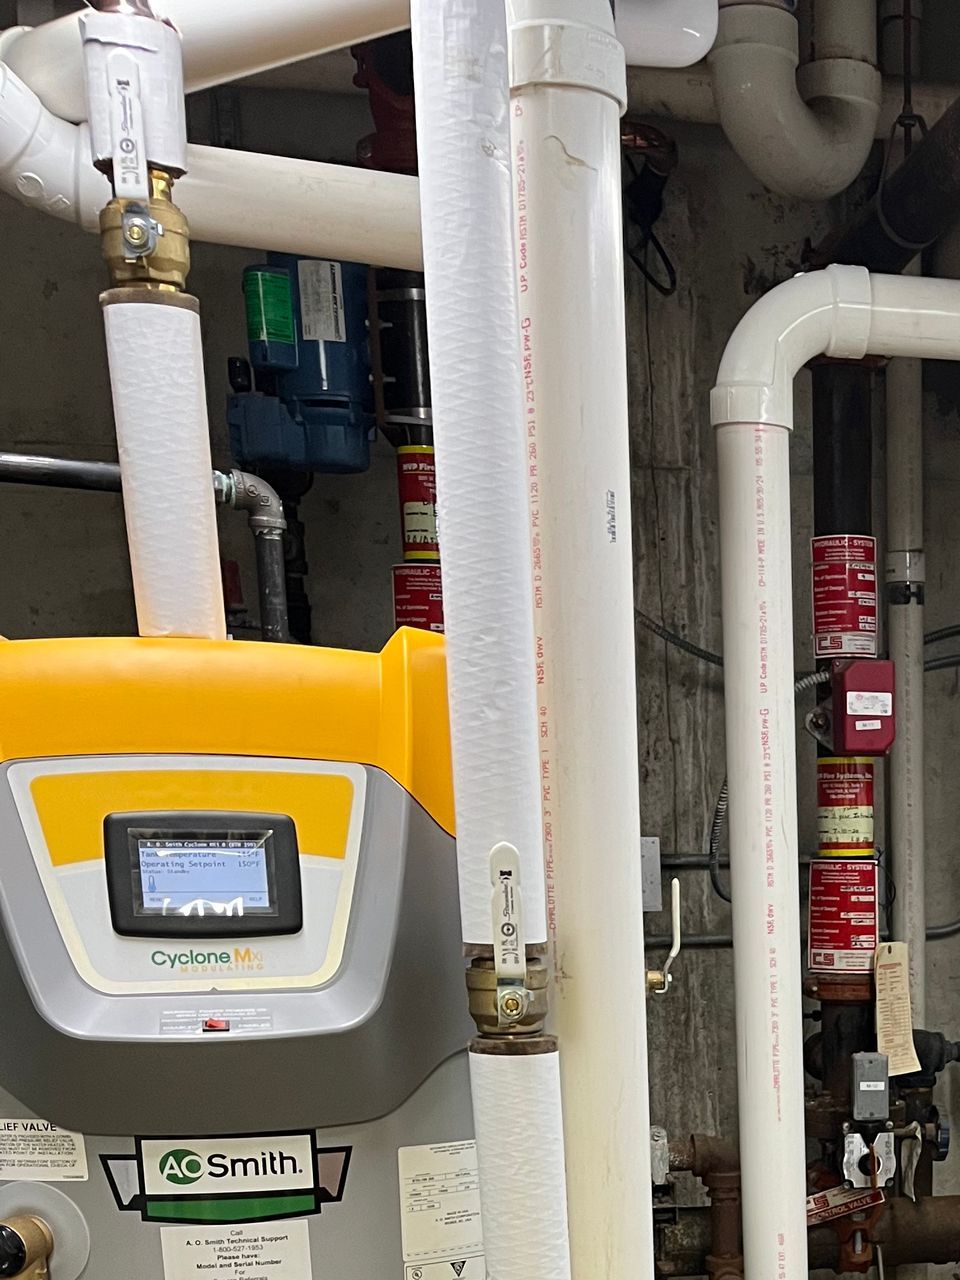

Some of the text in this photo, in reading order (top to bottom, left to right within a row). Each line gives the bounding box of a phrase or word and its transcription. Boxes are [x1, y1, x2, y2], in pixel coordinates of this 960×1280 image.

[528, 442, 536, 461] 260
[529, 482, 538, 504] 1120
[531, 509, 540, 528] PVC
[534, 586, 543, 609] ASTM
[540, 706, 547, 717] 40
[540, 721, 548, 738] SCH
[542, 759, 550, 779] TYPE
[543, 785, 551, 801] PVC
[141, 860, 185, 870] Operating
[188, 860, 227, 869] Setpoint
[151, 949, 231, 969] Cyclone
[180, 963, 265, 973] MODULATING
[21, 1122, 57, 1132] VALVE
[162, 1154, 205, 1178] AO
[811, 1196, 873, 1222] CONTROL VALVE
[205, 1238, 225, 1246] Smith
[226, 1237, 260, 1245] Technical
[261, 1235, 289, 1243] Support
[196, 1262, 218, 1270] Model
[233, 1260, 254, 1268] Serial
[255, 1259, 282, 1267] Number
